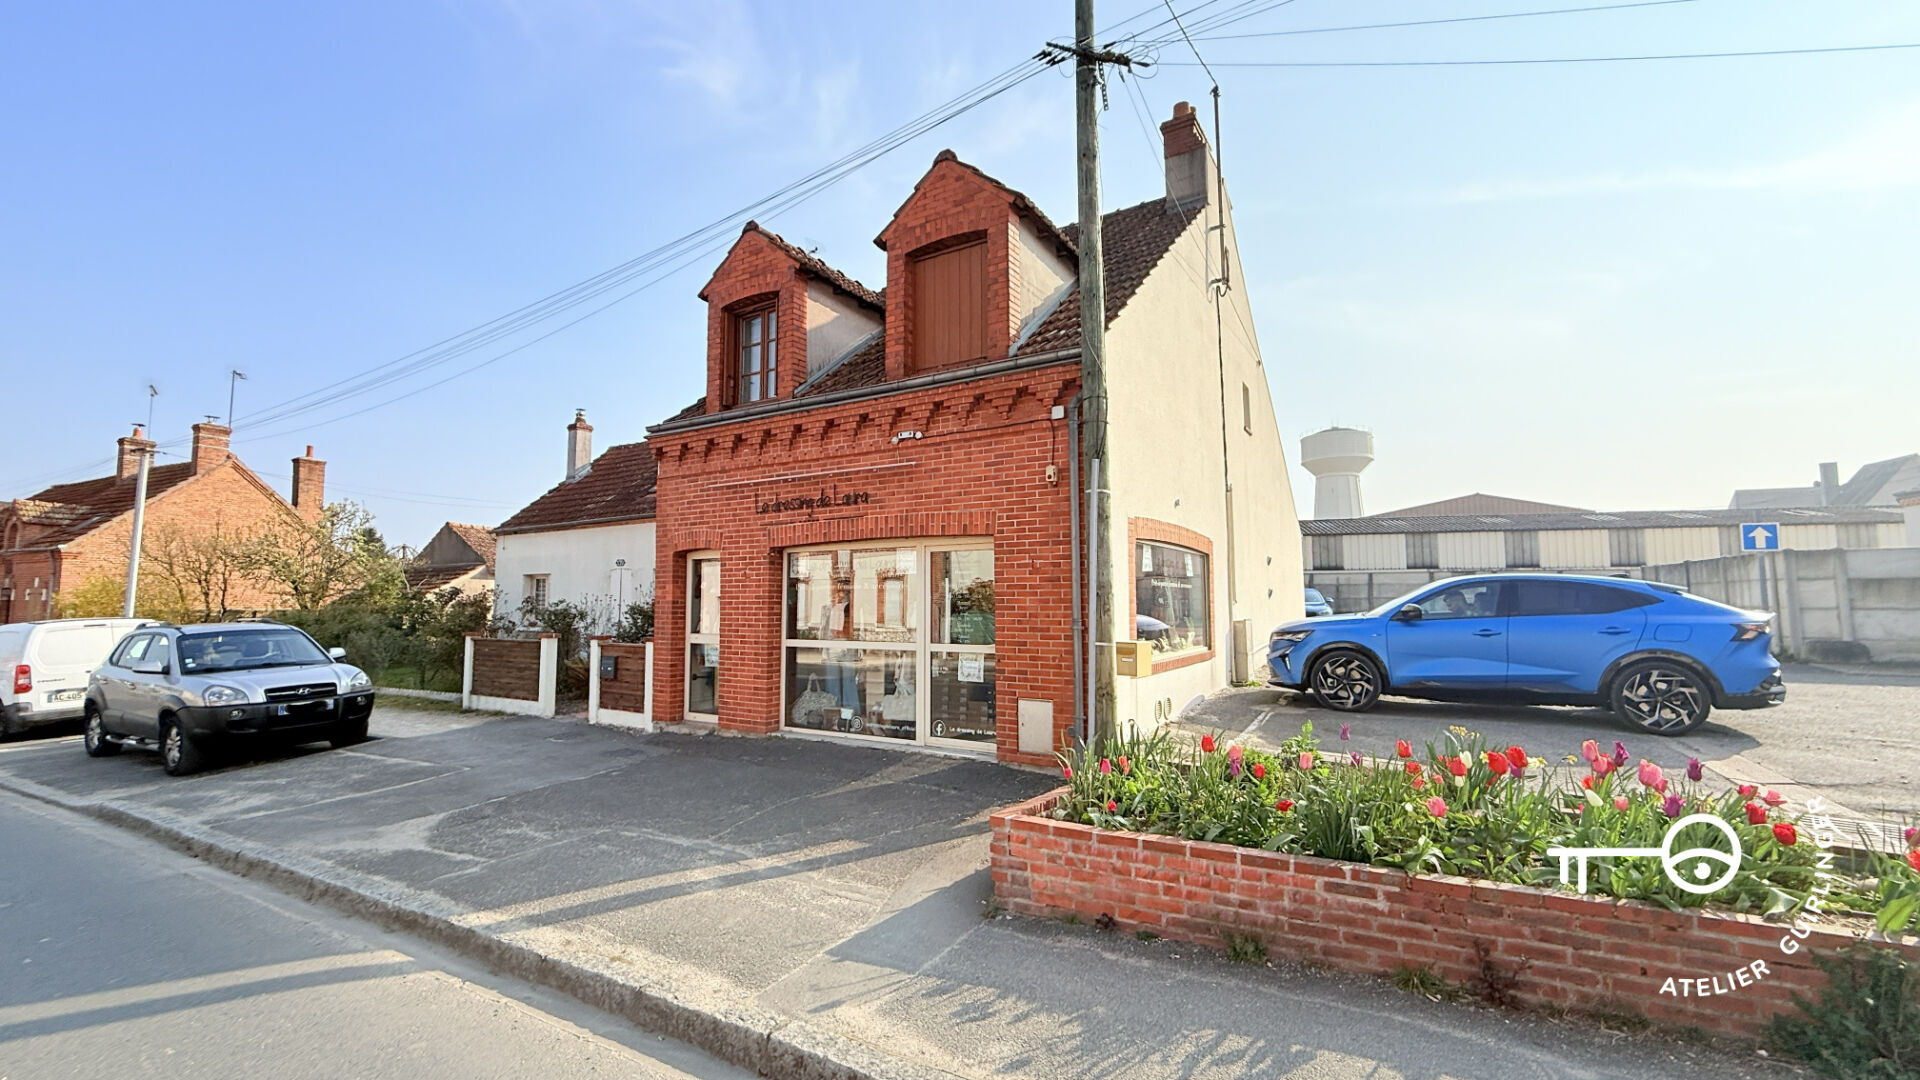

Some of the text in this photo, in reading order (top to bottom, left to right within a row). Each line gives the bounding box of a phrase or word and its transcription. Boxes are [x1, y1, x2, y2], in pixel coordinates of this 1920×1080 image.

[755, 484, 869, 517] Le dressing de Laura
